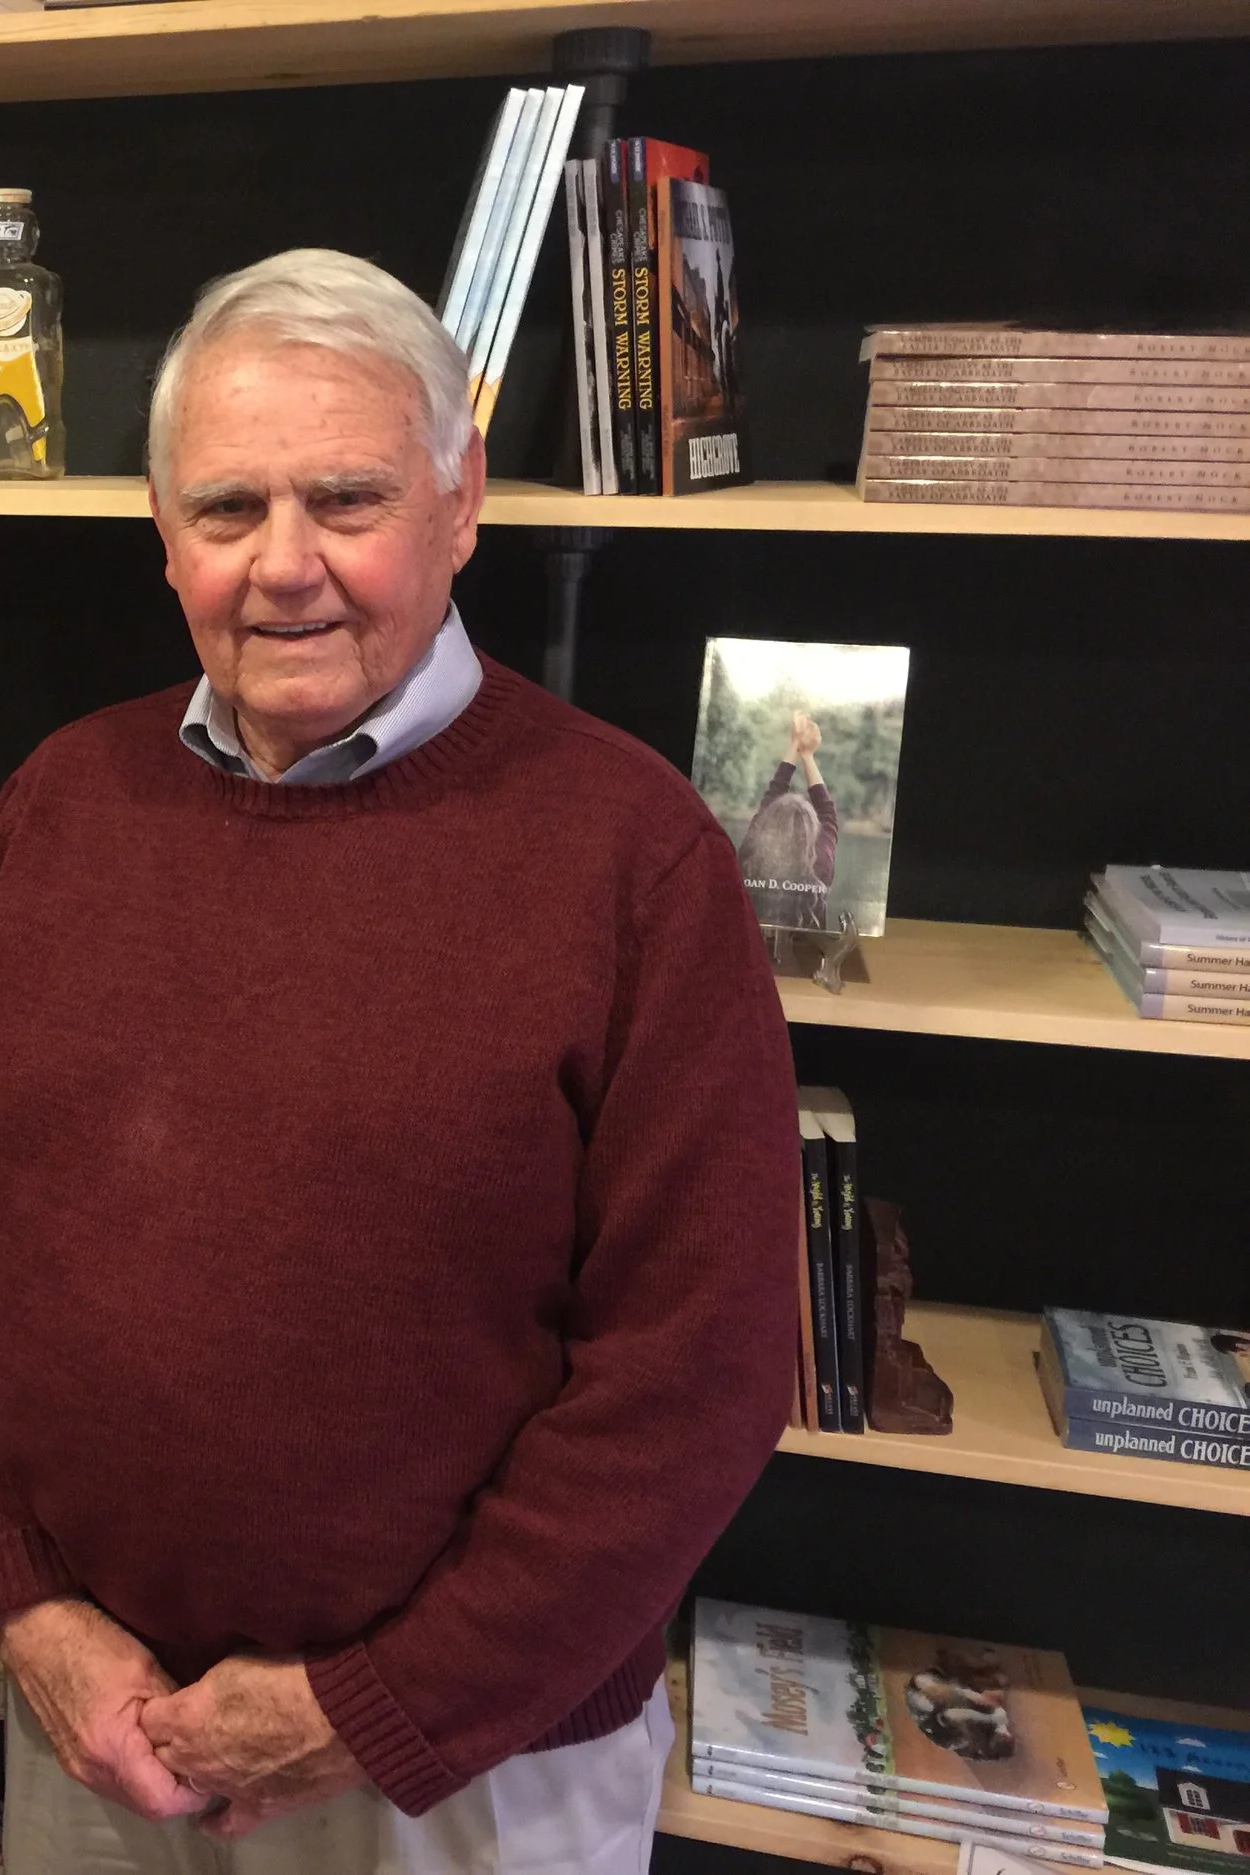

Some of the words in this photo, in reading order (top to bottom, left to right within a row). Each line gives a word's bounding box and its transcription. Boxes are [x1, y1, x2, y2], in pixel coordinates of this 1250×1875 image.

[611, 267, 628, 326] STORM
[634, 267, 650, 325] STORM
[615, 331, 632, 411] WARNING
[637, 330, 654, 410] WARNING
[782, 880, 828, 894] COOPER
[1187, 953, 1233, 966] Summer
[1190, 979, 1237, 992] Summer
[1187, 1003, 1234, 1016] Summer
[1107, 1322, 1168, 1388] CHOICES
[1092, 1396, 1175, 1422] unplanned
[1095, 1430, 1176, 1454] unplanned
[756, 1622, 804, 1663] Field
[754, 1665, 820, 1737] Mosey's
